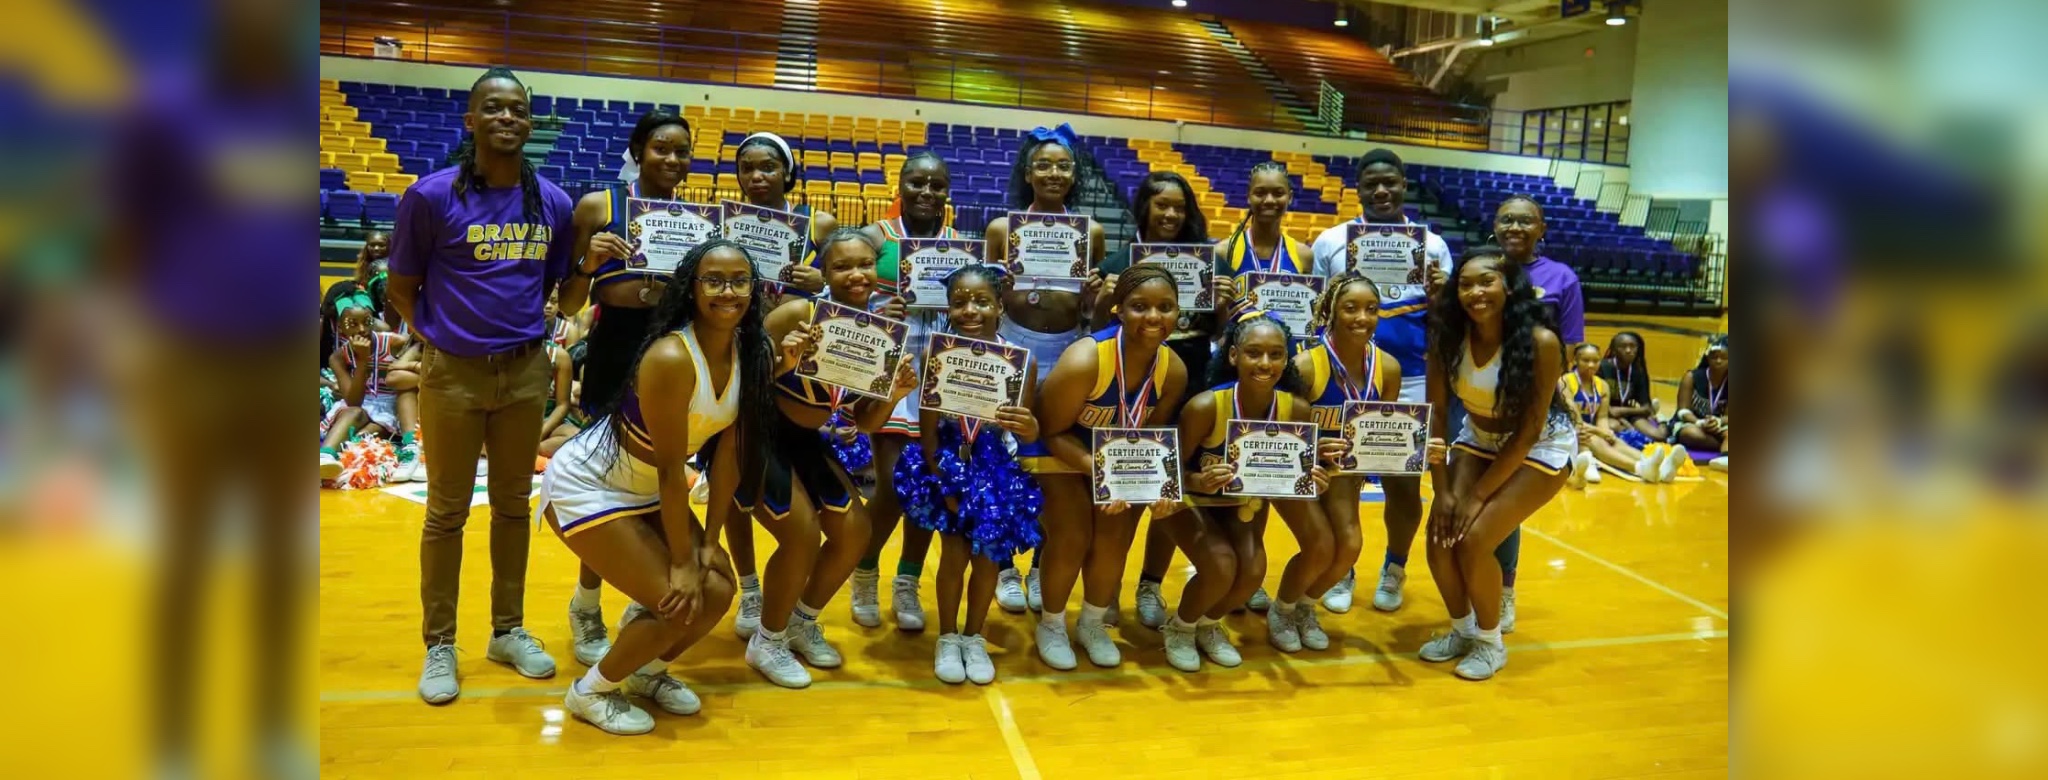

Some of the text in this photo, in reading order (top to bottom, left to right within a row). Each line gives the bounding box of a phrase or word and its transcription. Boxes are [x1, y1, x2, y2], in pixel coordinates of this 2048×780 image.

[645, 219, 705, 231] CERTIFICATE
[733, 222, 790, 240] CERTIFICATE
[1024, 230, 1074, 239] CERTIFICATE
[1360, 240, 1411, 248] CERTIFICATE
[474, 242, 548, 260] CHEER
[915, 256, 969, 266] CERTIFICATE
[1260, 289, 1310, 298] CERTIFICATE
[828, 324, 887, 348] CERTIFICATE
[946, 356, 1006, 374] CERTIFICATE
[1310, 404, 1342, 430] OIL
[1359, 420, 1413, 430] CERTIFICATE
[1243, 440, 1299, 451] CERTIFICATE
[1108, 448, 1161, 457] CERTIFICATE
